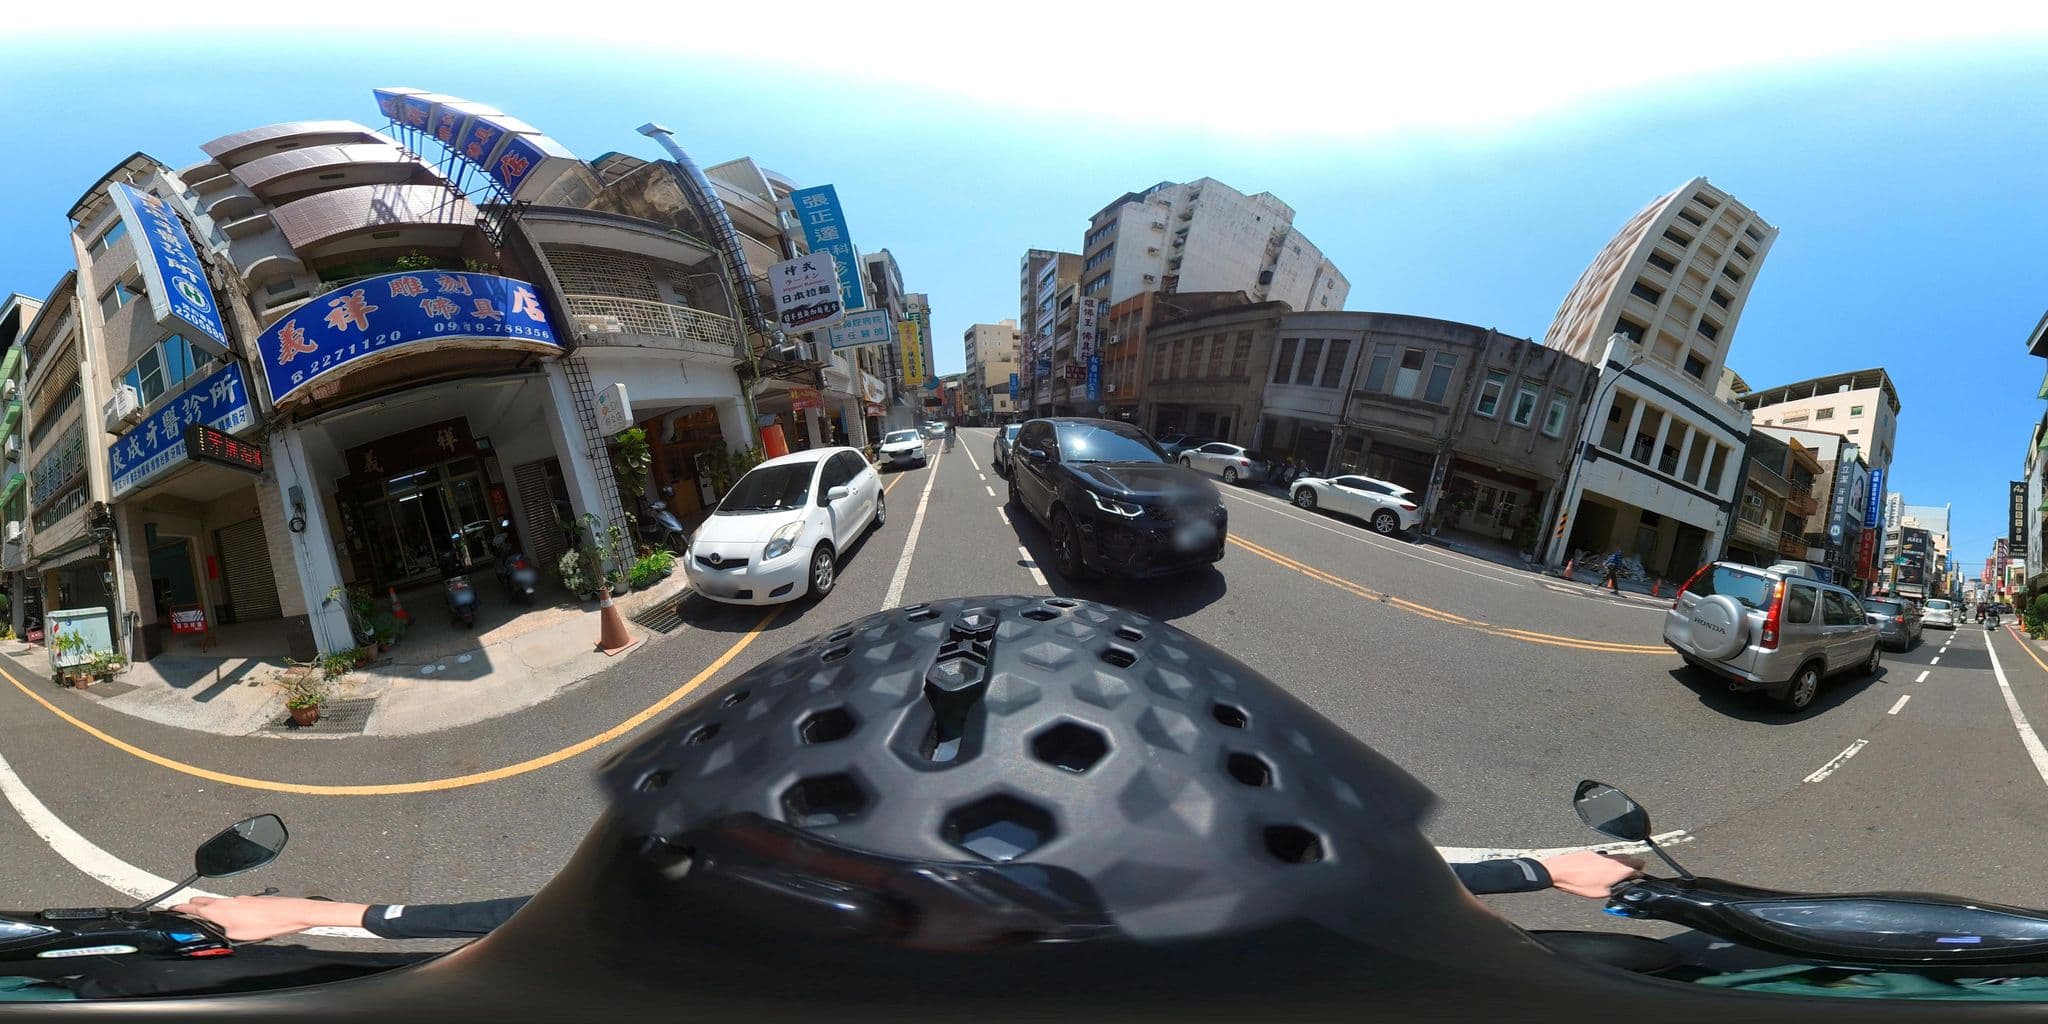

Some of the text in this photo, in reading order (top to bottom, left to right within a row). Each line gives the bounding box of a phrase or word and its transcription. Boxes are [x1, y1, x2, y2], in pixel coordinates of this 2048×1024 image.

[782, 285, 831, 304] 日本拉麵
[310, 330, 402, 374] 2271120
[112, 373, 239, 475] 良成牙醫診所
[1694, 617, 1727, 636] HONDA
